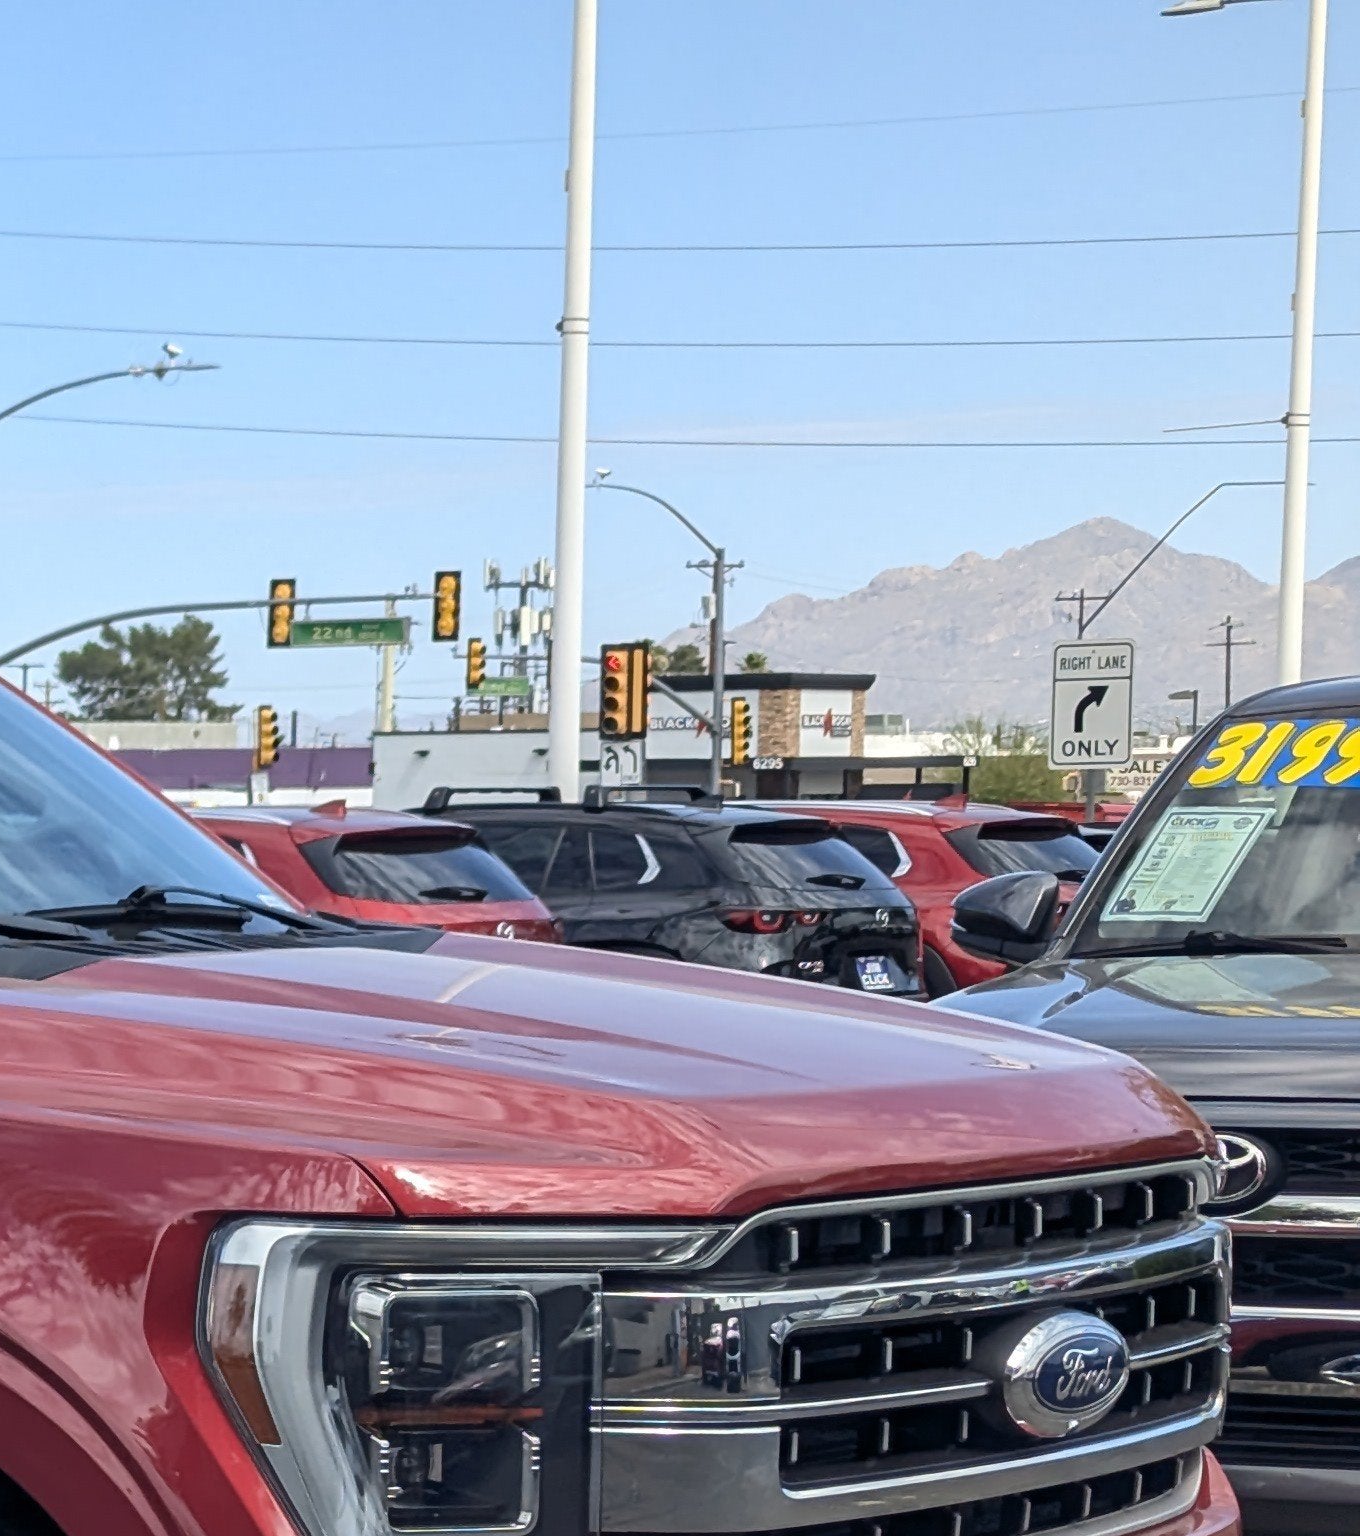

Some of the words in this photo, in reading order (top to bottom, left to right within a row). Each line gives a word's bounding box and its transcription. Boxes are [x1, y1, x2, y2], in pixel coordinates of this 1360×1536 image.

[1059, 656, 1092, 671] RIGHT
[1097, 655, 1127, 670] LANE
[1061, 739, 1119, 757] ONLY
[1119, 760, 1162, 773] ALE
[1056, 1347, 1111, 1400] Ford
